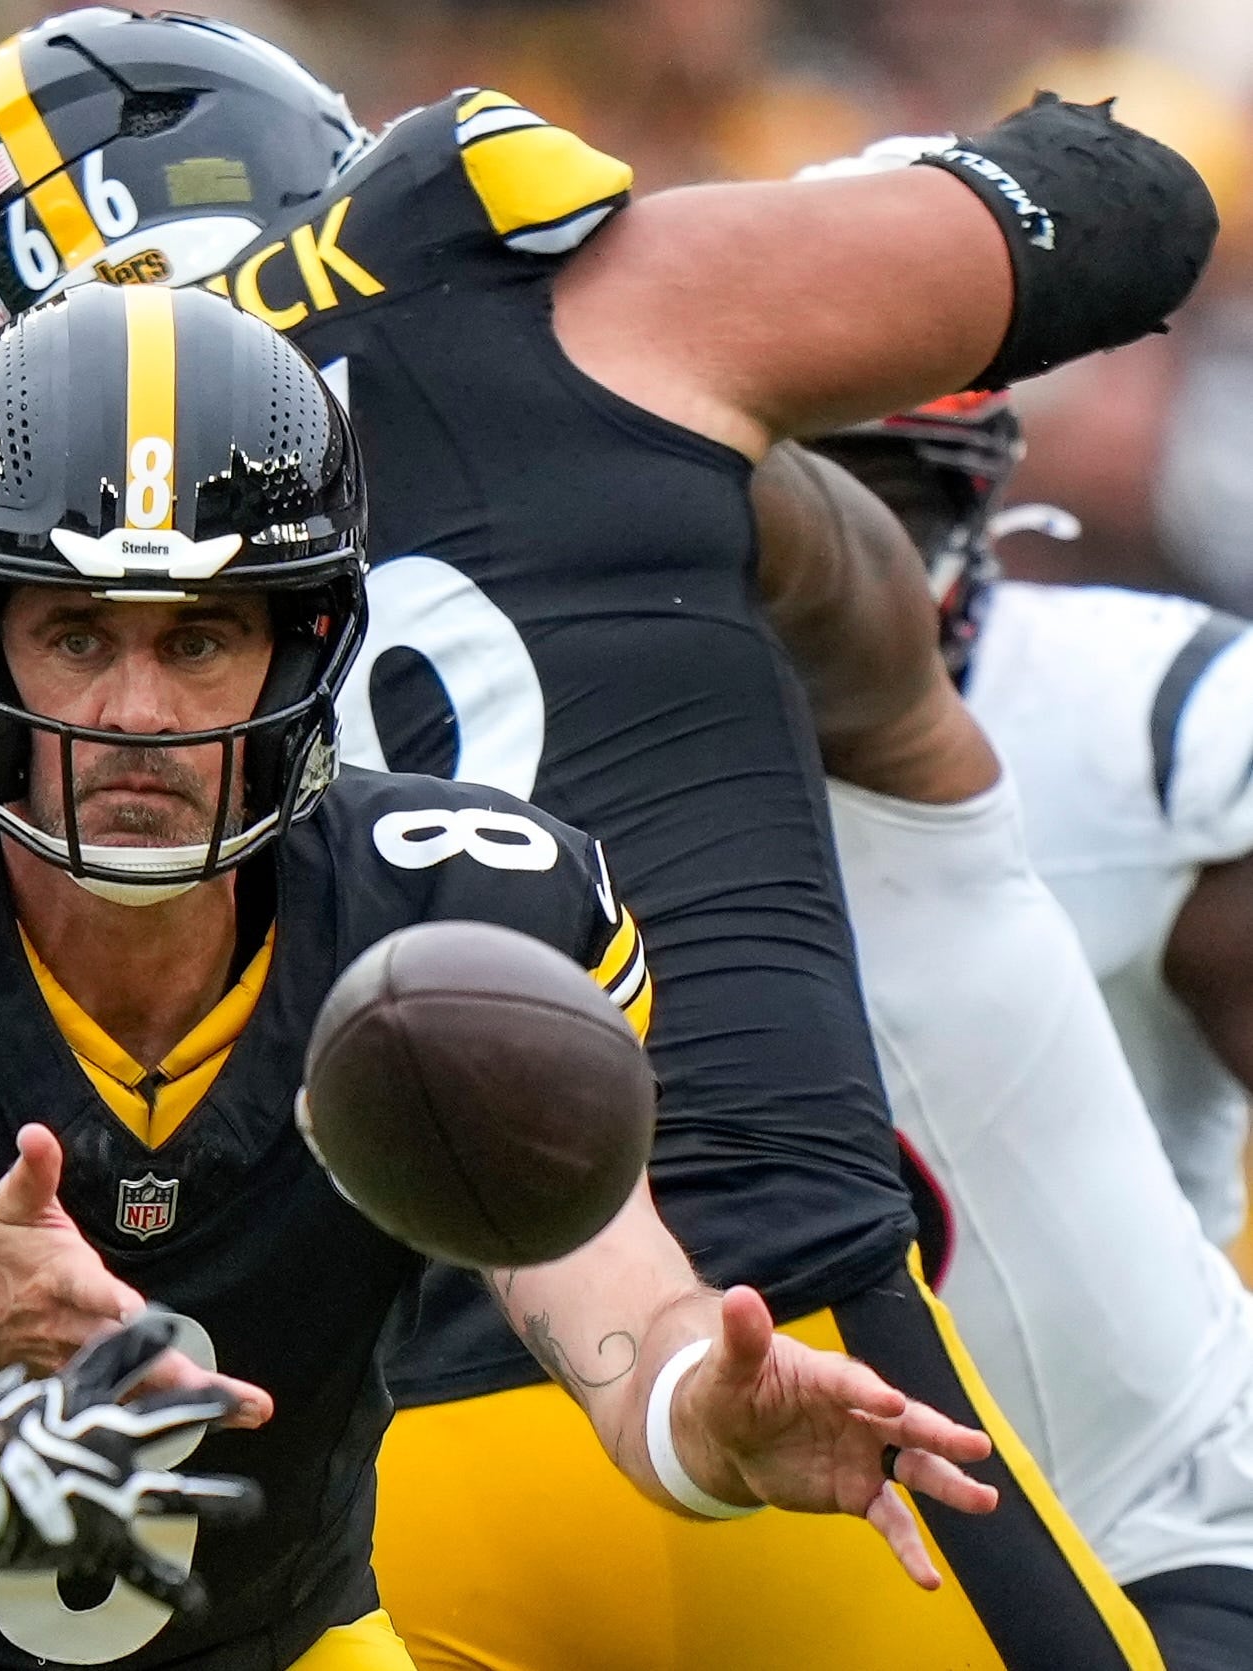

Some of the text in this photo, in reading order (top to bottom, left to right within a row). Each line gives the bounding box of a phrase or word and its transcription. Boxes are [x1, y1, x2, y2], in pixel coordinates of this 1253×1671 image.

[205, 196, 386, 331] CK
[125, 436, 174, 530] 8
[121, 541, 169, 555] Steelers
[372, 808, 559, 871] 8
[126, 1205, 167, 1229] NFL
